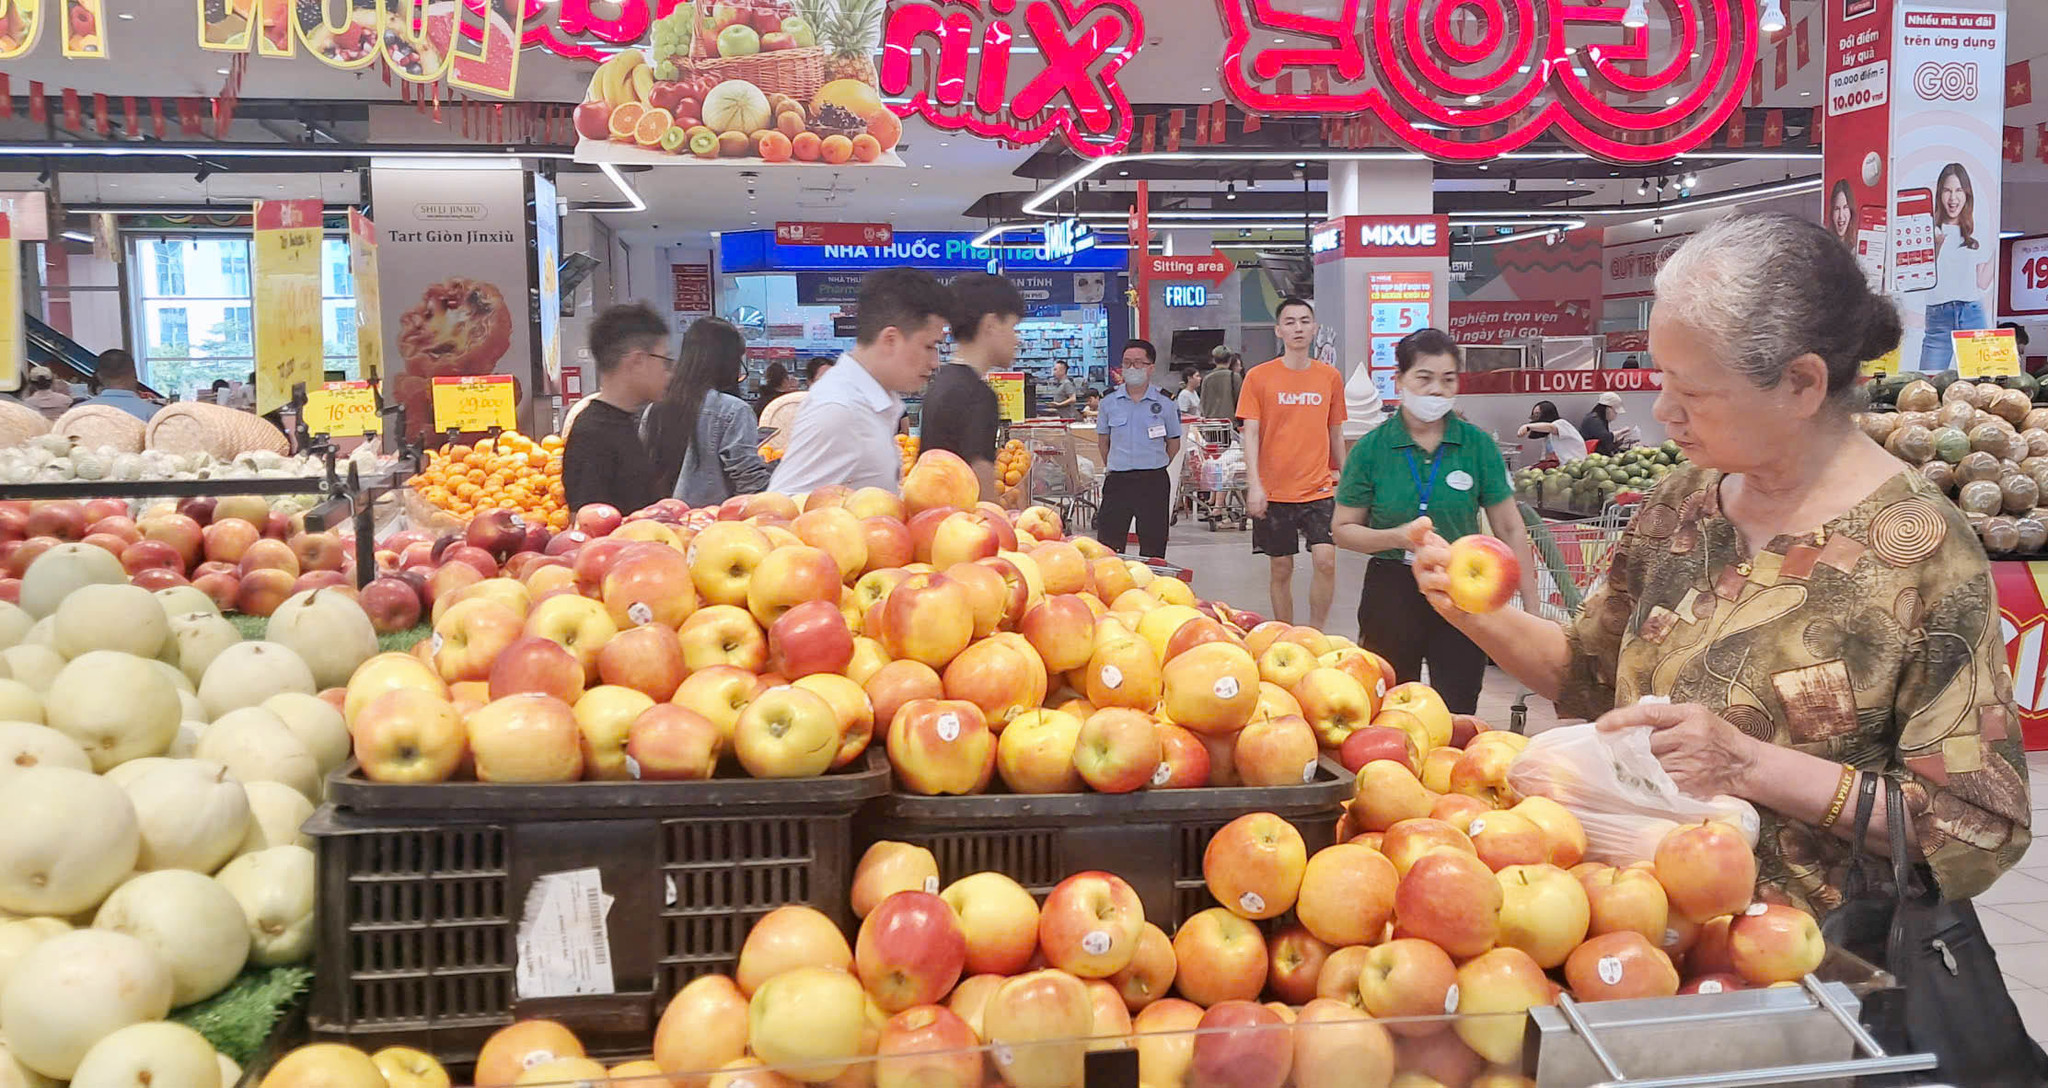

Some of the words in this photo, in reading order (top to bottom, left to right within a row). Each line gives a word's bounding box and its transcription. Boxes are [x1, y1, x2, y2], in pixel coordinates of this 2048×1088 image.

[1904, 34, 1931, 46] trên
[1934, 35, 1959, 49] ứng
[1963, 36, 1996, 50] dụng
[1913, 61, 1978, 101] GO!
[1833, 89, 1871, 111] 10.000
[388, 230, 422, 243] Tart
[426, 229, 463, 243] Giòn
[1361, 223, 1437, 247] MIXUE
[1153, 260, 1193, 274] Sitting
[1197, 262, 1224, 272] area
[1165, 286, 1206, 307] FRICO
[1450, 312, 1499, 327] nghiệm
[1503, 312, 1530, 324] trọn
[1535, 313, 1558, 324] vẹn
[1463, 329, 1495, 342] ngày
[1525, 374, 1530, 391] I
[1540, 372, 1593, 391] LOVE
[1602, 372, 1642, 390] YOU
[1278, 392, 1323, 406] KAMITO
